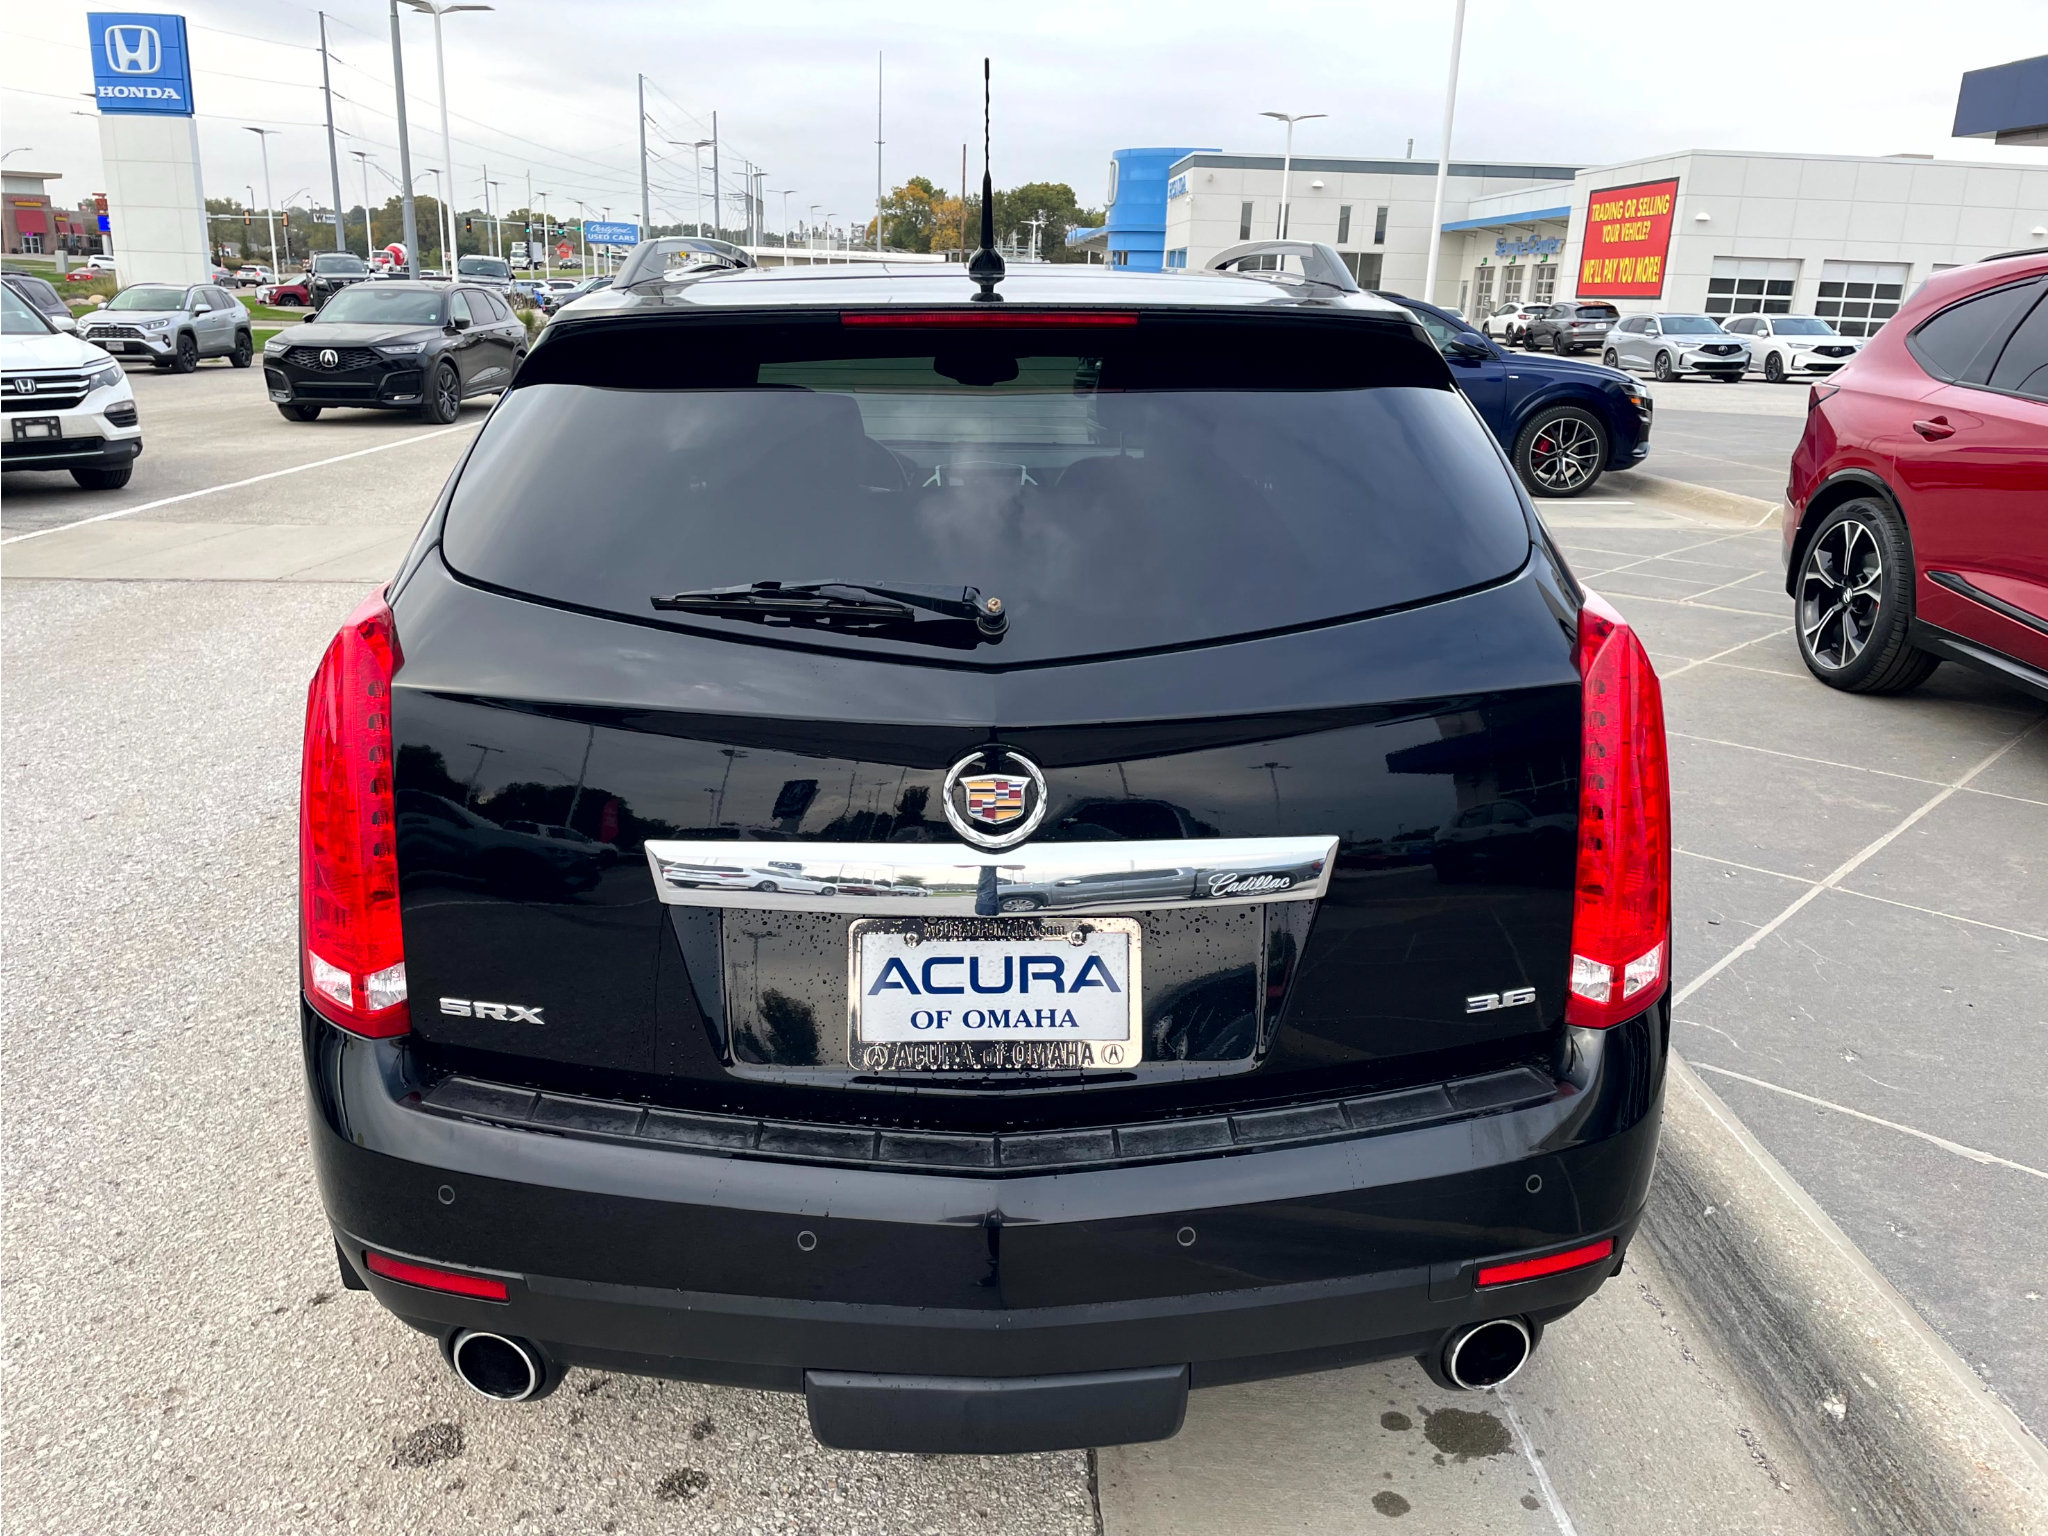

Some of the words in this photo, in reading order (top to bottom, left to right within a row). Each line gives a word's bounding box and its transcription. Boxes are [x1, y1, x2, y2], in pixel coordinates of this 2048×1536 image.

[97, 86, 181, 99] HONDA
[1591, 203, 1624, 222] TRADING
[1624, 199, 1638, 219] OR
[1637, 194, 1670, 217] SELLING
[590, 224, 632, 234] Certified
[1602, 224, 1620, 243] YOUR
[1620, 221, 1651, 241] VEHICLE?
[1495, 237, 1528, 256] Service
[1527, 234, 1566, 255] Center
[1583, 259, 1602, 284] WE'LL
[1603, 257, 1618, 283] PAY
[1619, 257, 1635, 283] YOU
[1635, 256, 1661, 283] MORE!
[1208, 873, 1290, 896] Cadillac
[867, 955, 1122, 995] ACURA
[439, 997, 546, 1025] SRX
[1466, 987, 1536, 1014] 3.6
[910, 1010, 953, 1030] OF
[962, 1008, 1080, 1029] OMAHA
[891, 1043, 975, 1067] ACURA
[1012, 1042, 1095, 1066] OMAHA
